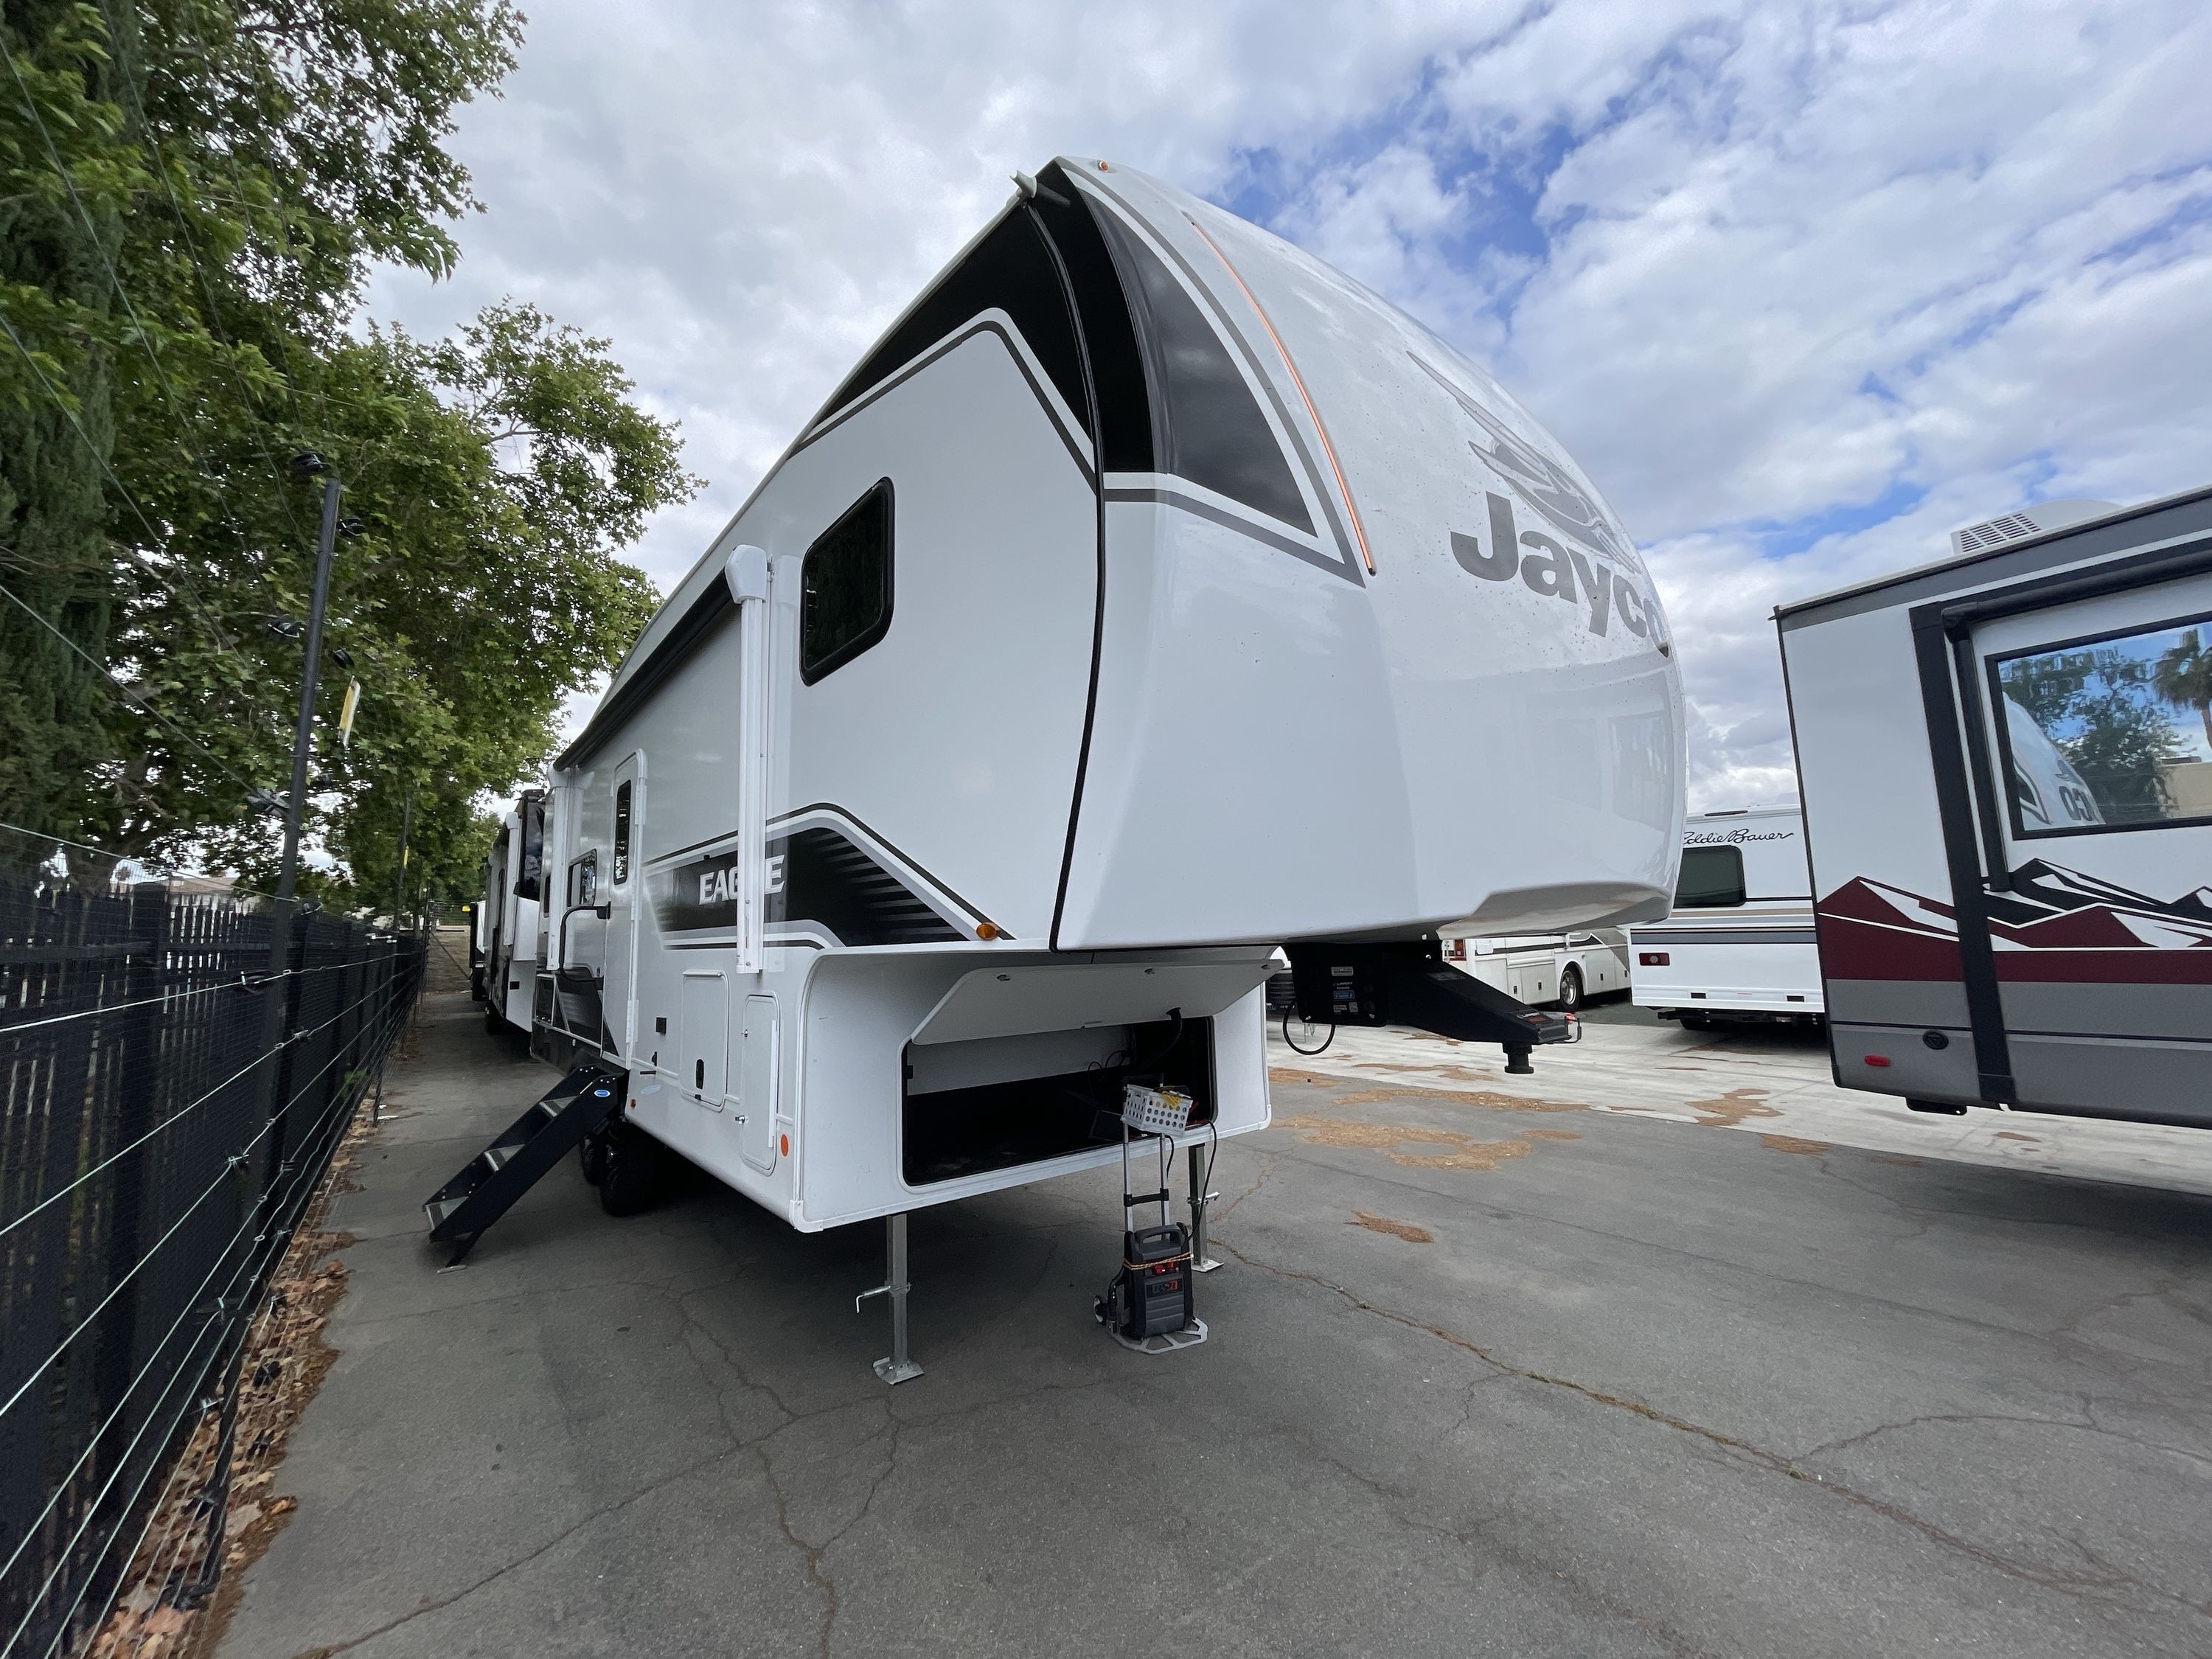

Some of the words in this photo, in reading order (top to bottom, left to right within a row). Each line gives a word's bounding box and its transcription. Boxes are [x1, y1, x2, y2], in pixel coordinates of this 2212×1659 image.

[1450, 490, 1669, 658] Jayco
[1683, 831, 1726, 845] Eddie
[1727, 828, 1794, 844] Bauer
[699, 854, 785, 905] EAGE
